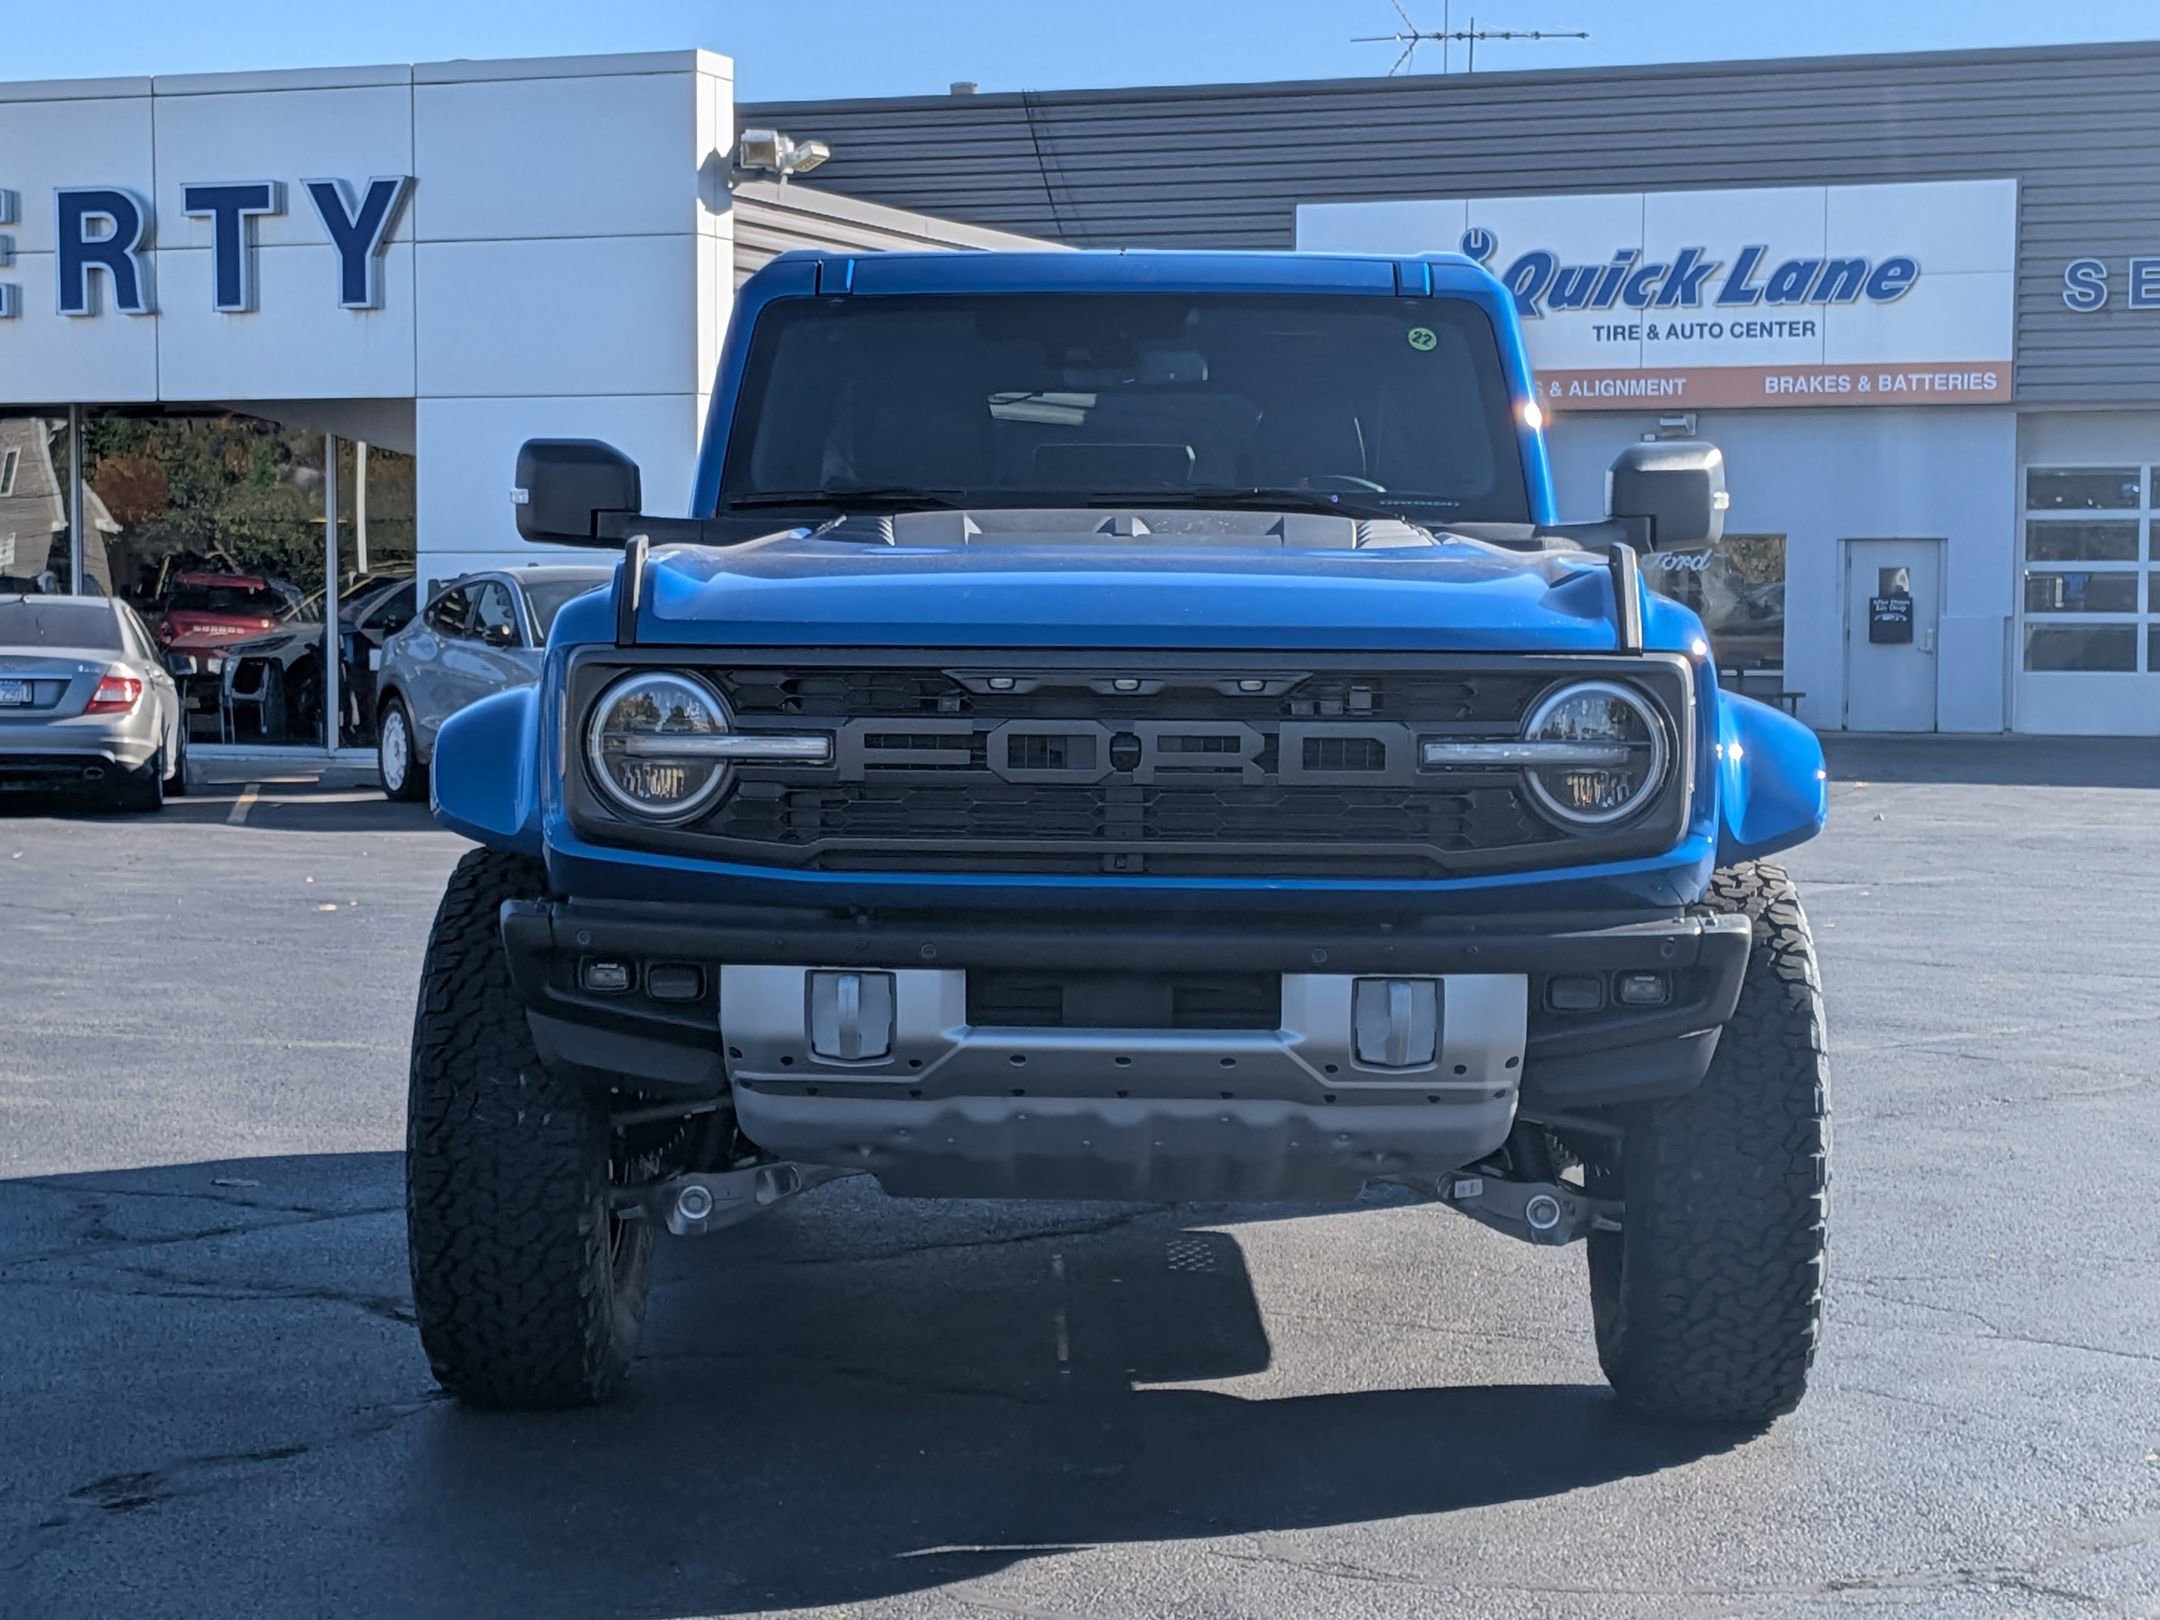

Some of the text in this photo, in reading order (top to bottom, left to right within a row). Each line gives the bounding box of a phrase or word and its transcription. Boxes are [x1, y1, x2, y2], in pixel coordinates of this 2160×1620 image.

[0, 175, 416, 318] RTY
[1502, 245, 1921, 319] Quick Lane
[2063, 256, 2160, 312] SE
[1411, 330, 1433, 347] 22
[1593, 320, 1816, 341] TIRE & AUTO CENTER
[1550, 380, 1562, 397] &
[1568, 378, 1687, 397] ALIGNMENT
[1765, 372, 1997, 394] BRAKES & BATTERIES
[839, 717, 1410, 785] FORD
